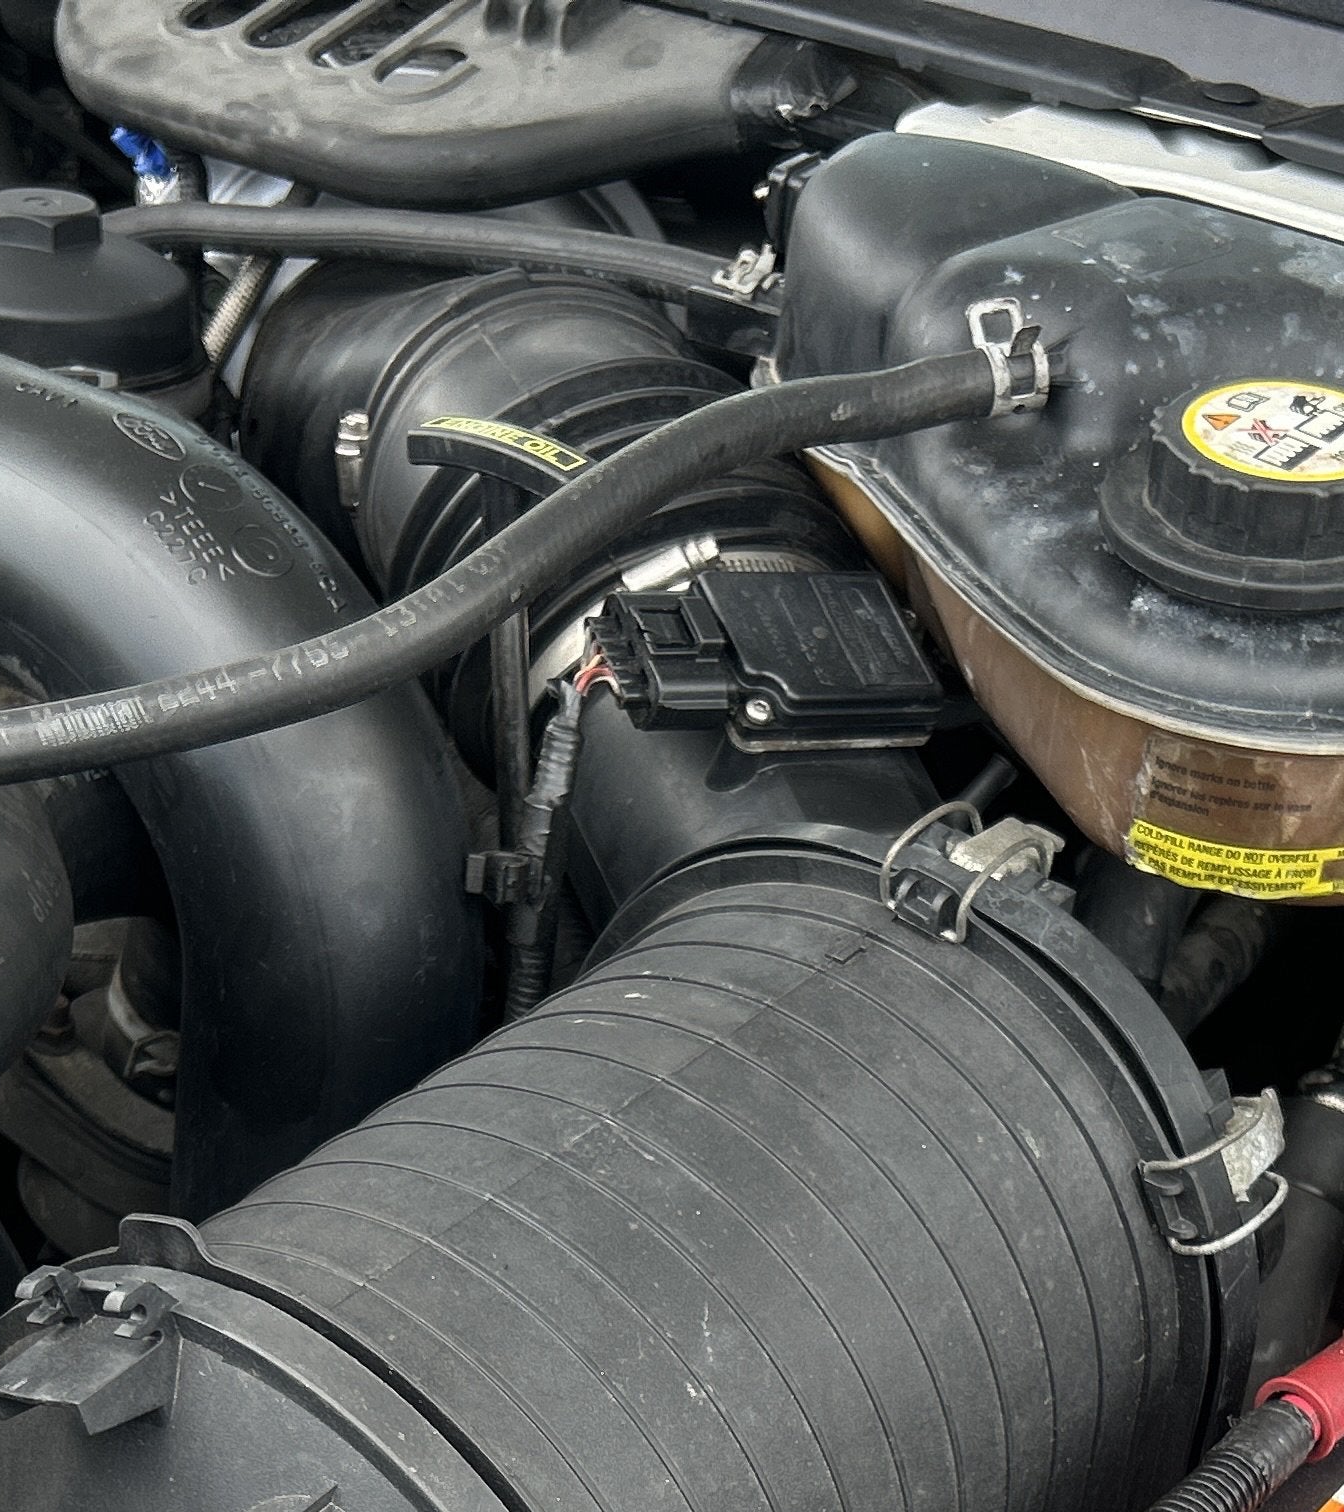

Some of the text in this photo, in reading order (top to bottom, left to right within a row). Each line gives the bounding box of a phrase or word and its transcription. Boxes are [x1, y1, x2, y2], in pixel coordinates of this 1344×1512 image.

[442, 417, 564, 463] ENGINE OIL
[1150, 777, 1187, 796] Ignorer
[1156, 756, 1275, 791] Ignore marks on bottle
[1137, 824, 1319, 865] COLD FILL RANGE DO NOT OVERFILL
[1181, 856, 1195, 867] DE
[1197, 860, 1273, 879] REMPLISSAGE
[1285, 868, 1316, 878] FROID
